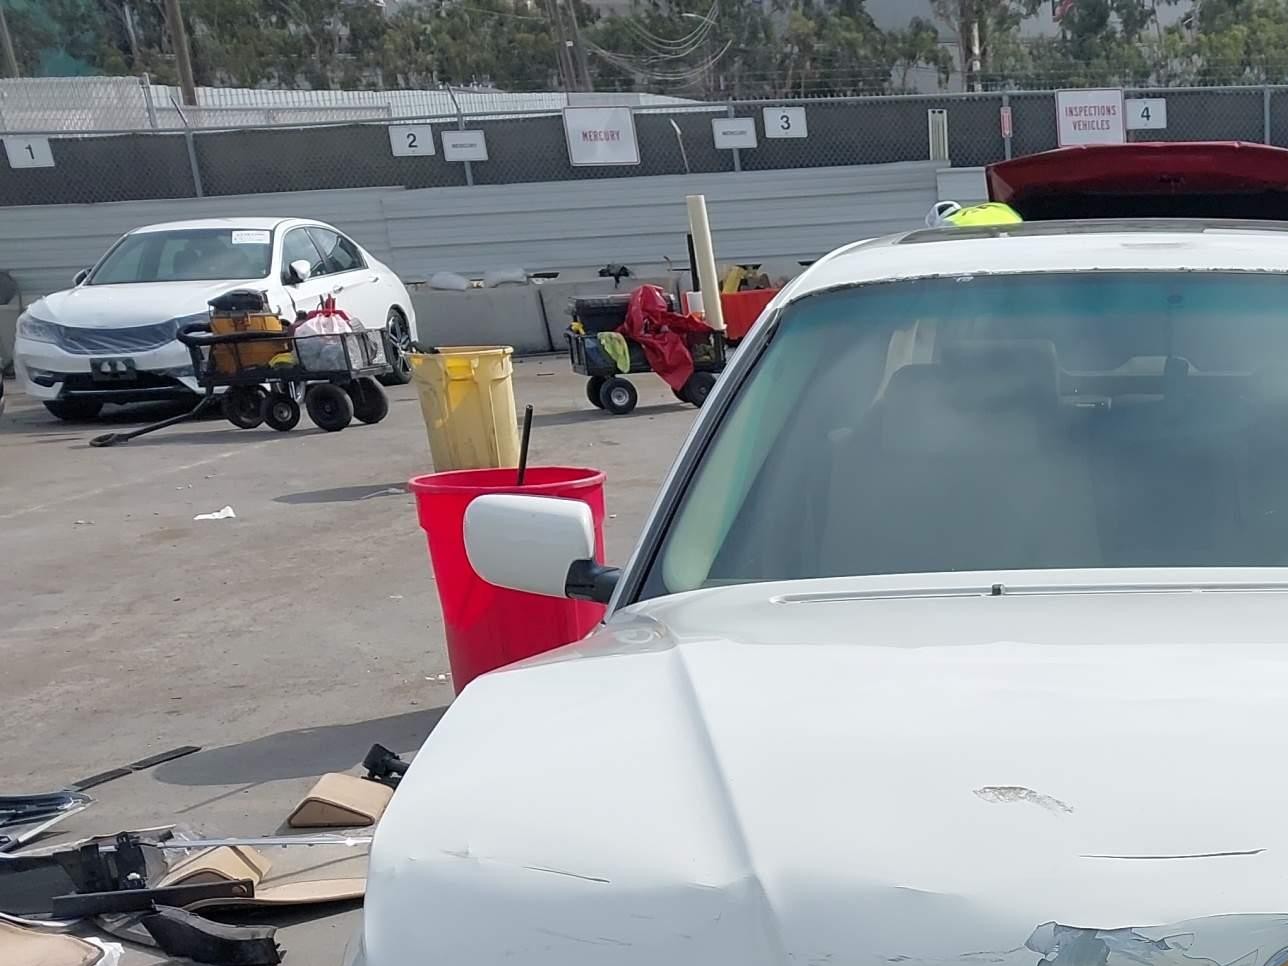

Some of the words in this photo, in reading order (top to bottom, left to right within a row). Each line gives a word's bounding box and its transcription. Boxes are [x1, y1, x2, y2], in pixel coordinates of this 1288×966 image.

[1065, 105, 1116, 117] INSPECTIONS
[1140, 107, 1151, 121] 4
[780, 115, 791, 130] 3
[1072, 119, 1110, 131] VEHICLES
[406, 133, 418, 148] 2
[581, 130, 621, 142] MERCURY
[25, 144, 34, 160] 1
